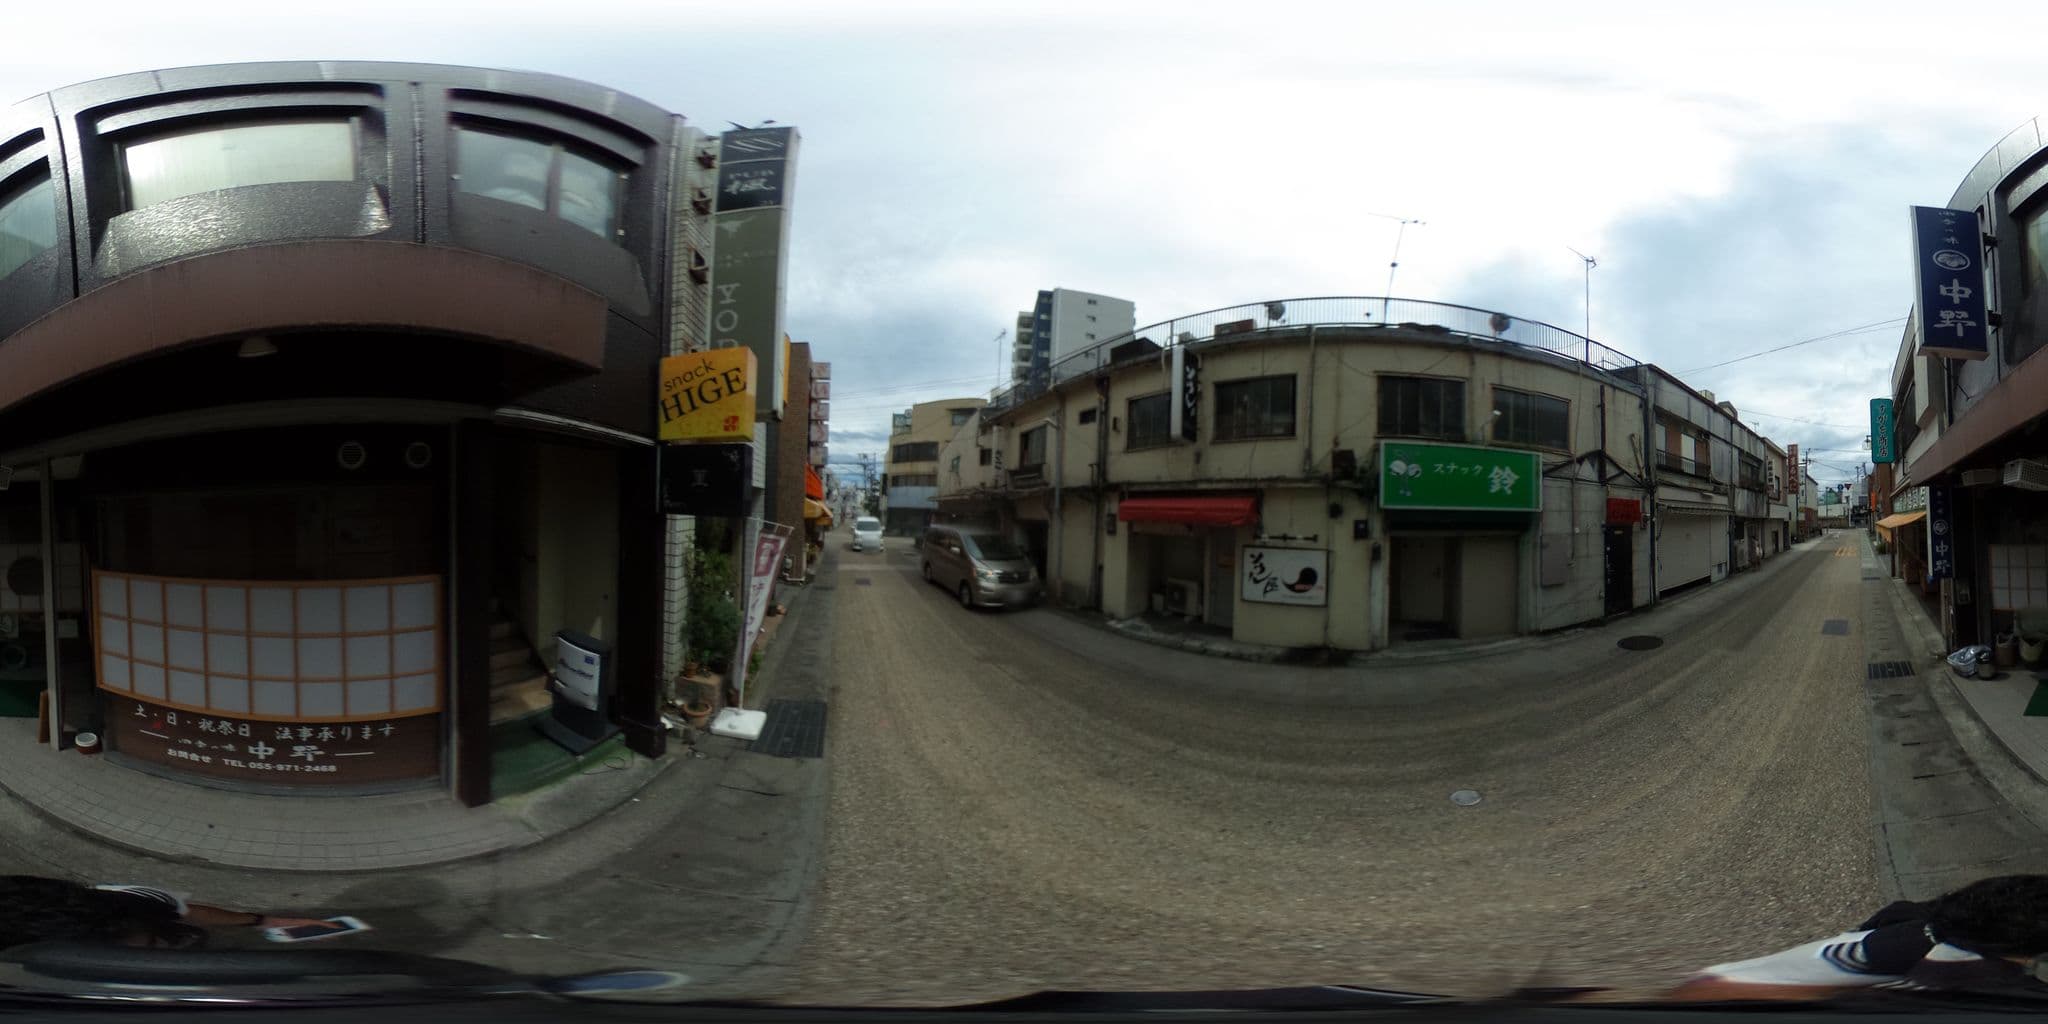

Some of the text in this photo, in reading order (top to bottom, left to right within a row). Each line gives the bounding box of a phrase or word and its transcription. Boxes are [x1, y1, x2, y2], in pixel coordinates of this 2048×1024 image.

[1933, 278, 1977, 337] 中野
[664, 358, 716, 392] snack
[661, 367, 748, 424] HIGE
[1432, 462, 1521, 495] スナック 鈴
[1934, 539, 1952, 575] 中野
[274, 722, 396, 742] 法事承ります
[222, 758, 247, 768] TEL
[248, 762, 337, 773] 055-971-2468
[248, 740, 327, 762] 中野
